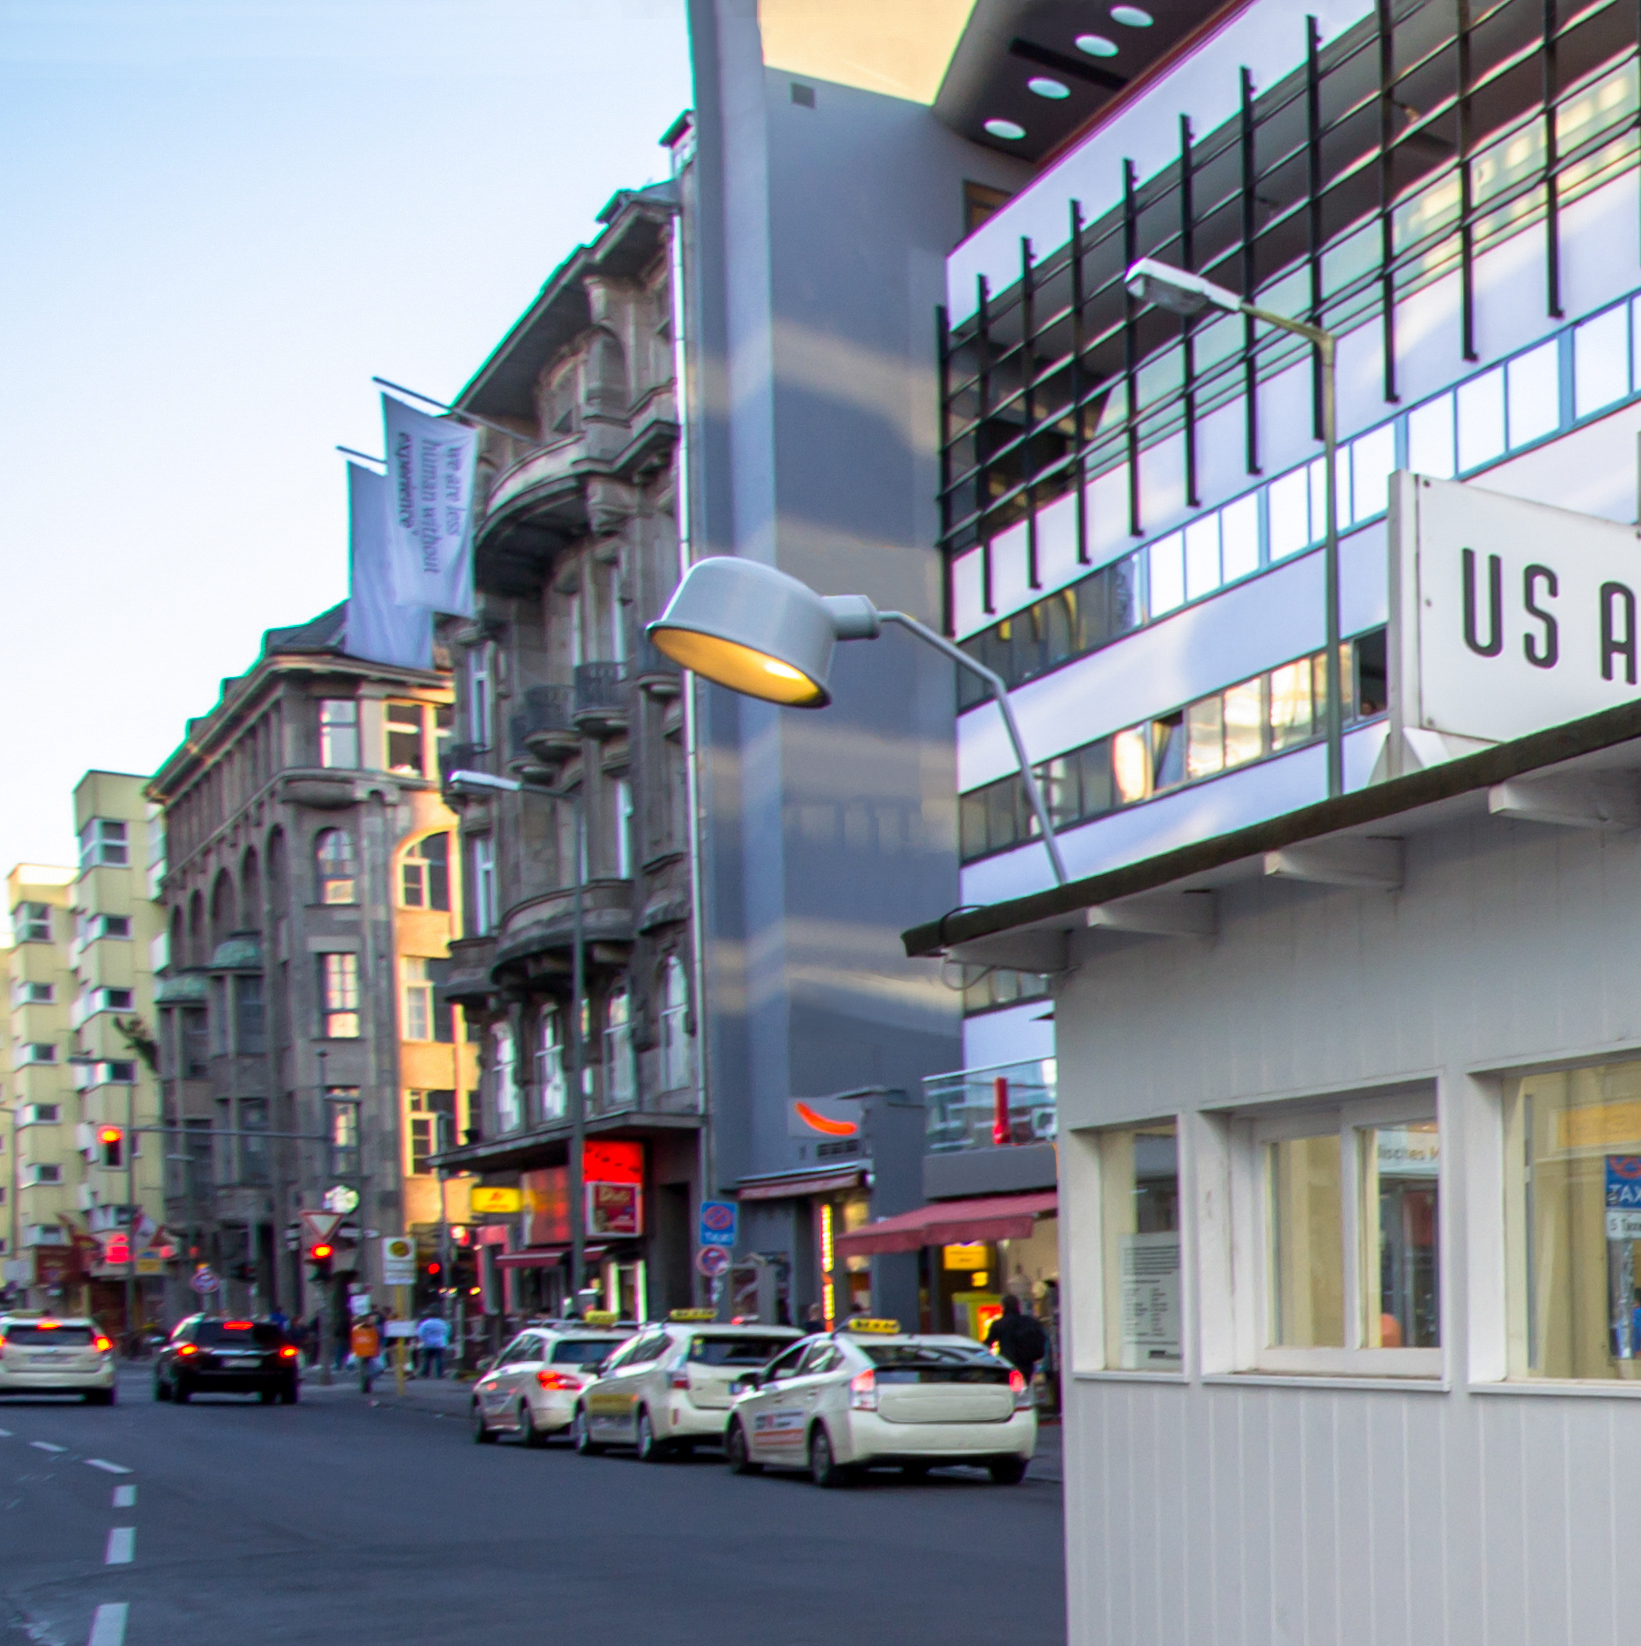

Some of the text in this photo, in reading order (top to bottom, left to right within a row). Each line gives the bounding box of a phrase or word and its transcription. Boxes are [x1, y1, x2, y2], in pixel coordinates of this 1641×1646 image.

[421, 438, 443, 575] human without
[1462, 547, 1559, 670] US
